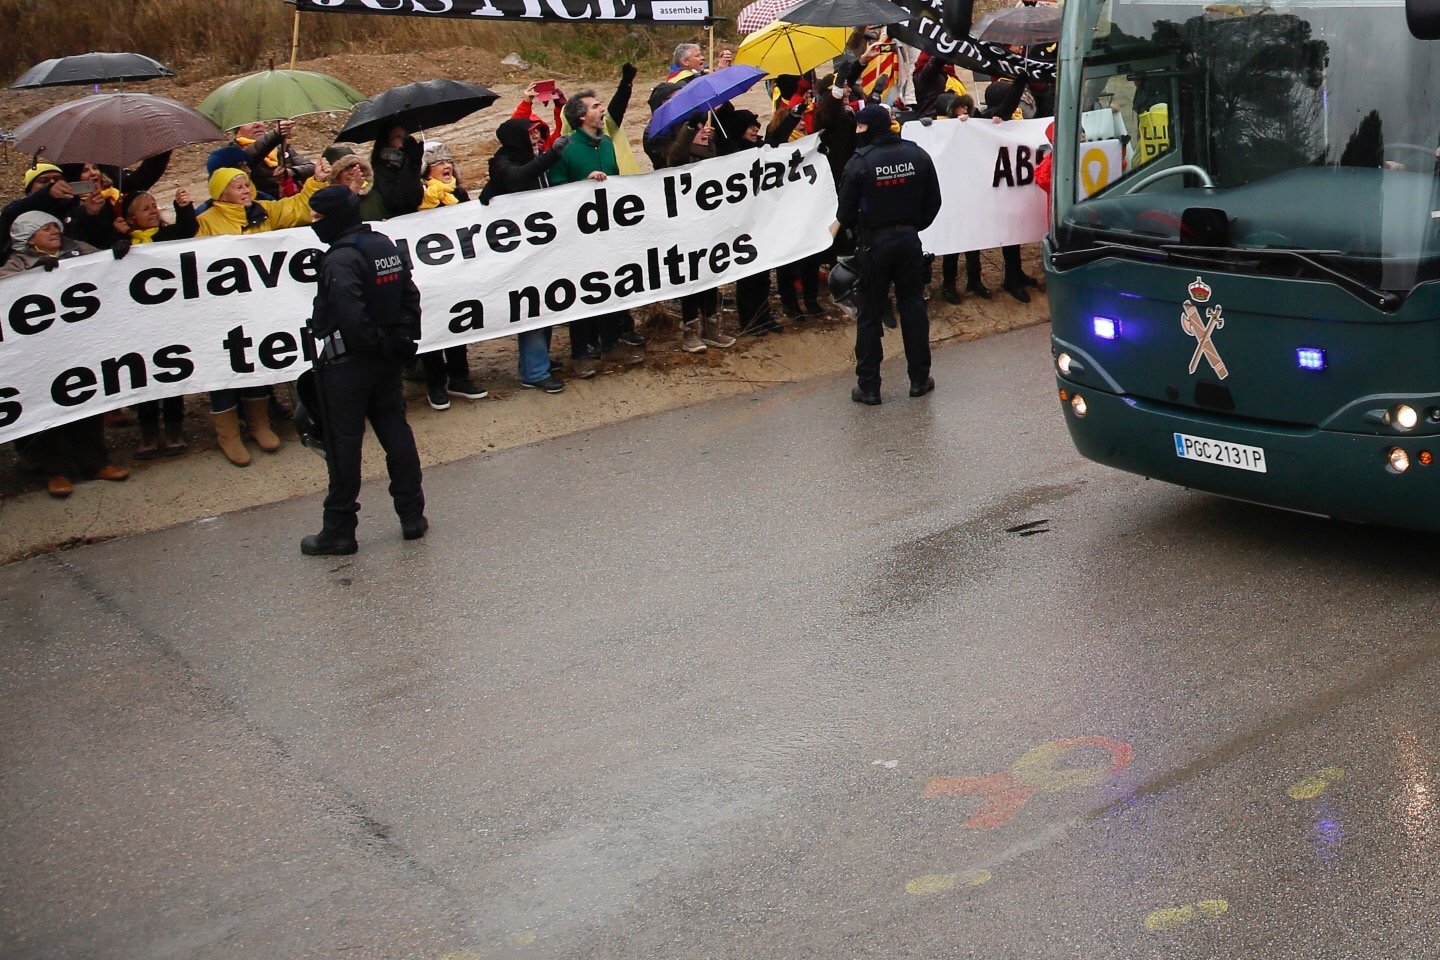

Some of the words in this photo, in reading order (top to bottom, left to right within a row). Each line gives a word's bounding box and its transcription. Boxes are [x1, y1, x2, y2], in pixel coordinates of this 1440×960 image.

[659, 6, 703, 15] assemblea
[875, 162, 915, 176] POLICIA
[0, 282, 101, 341] es
[576, 189, 645, 235] de
[374, 254, 402, 270] POLICIA
[50, 344, 195, 407] ens
[448, 298, 484, 334] a
[508, 232, 758, 323] nosaltres
[1184, 438, 1212, 459] PGC
[1214, 443, 1249, 466] 2131
